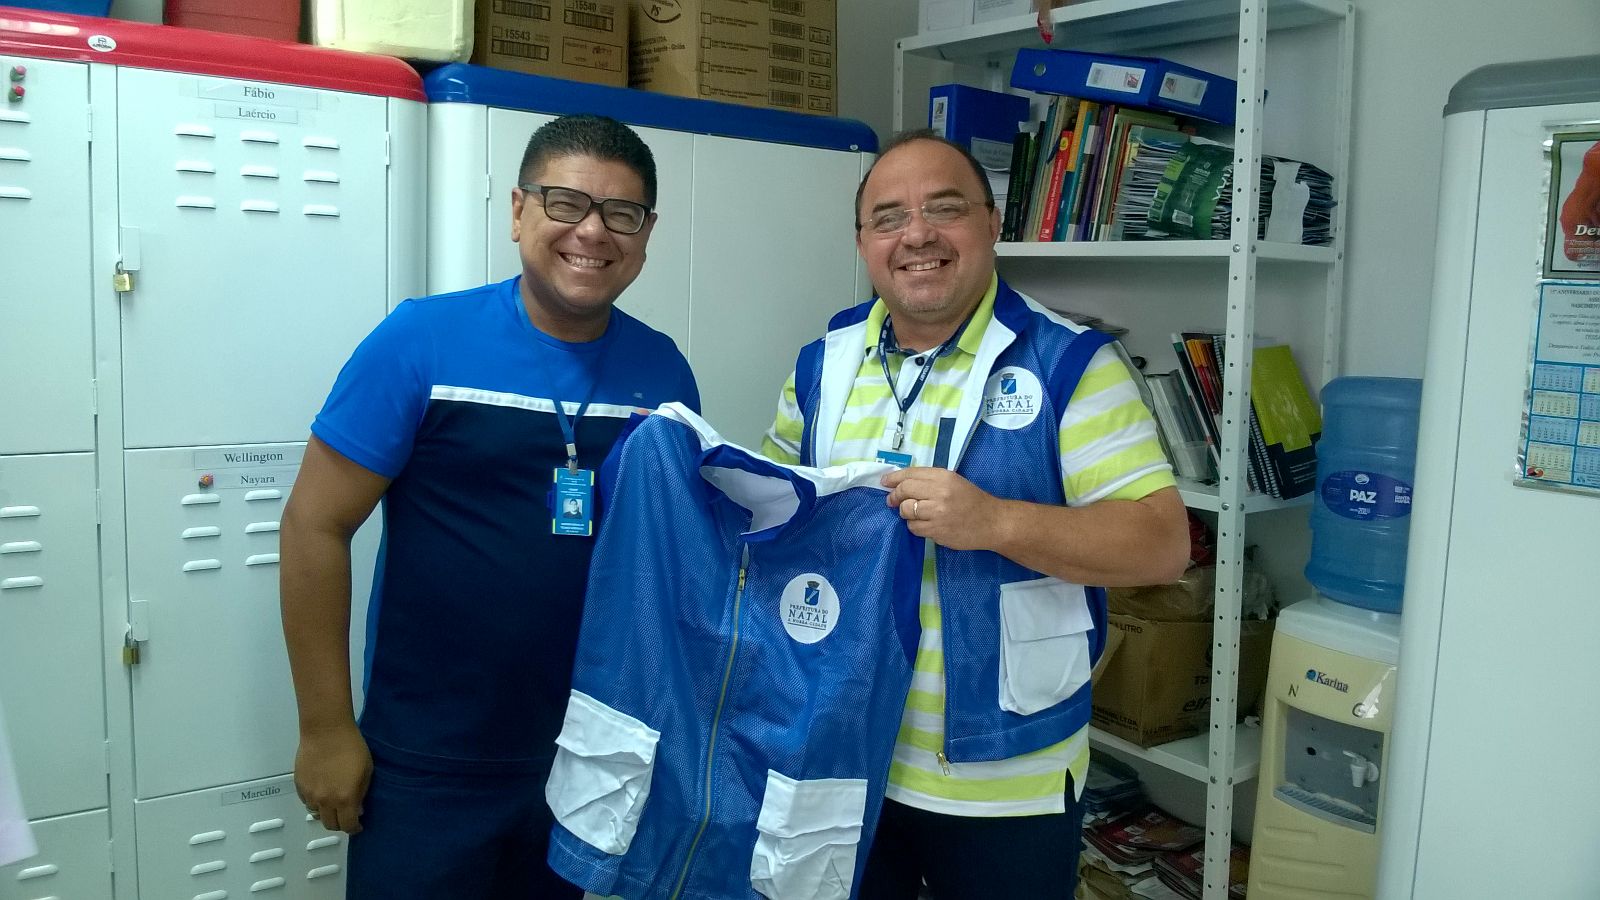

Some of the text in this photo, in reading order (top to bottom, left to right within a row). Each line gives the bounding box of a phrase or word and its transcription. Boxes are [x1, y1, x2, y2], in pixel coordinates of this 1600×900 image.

[505, 28, 531, 41] 15543
[244, 86, 275, 99] Fábio
[239, 108, 276, 120] Laércio
[986, 400, 1033, 410] NATAL
[224, 452, 283, 464] Wellington
[240, 476, 275, 486] Nayara
[1350, 489, 1377, 504] PAZ
[790, 604, 821, 613] PREFEITURA
[788, 608, 827, 623] NATAL
[1120, 625, 1142, 633] LITRO
[1316, 672, 1349, 693] Karina
